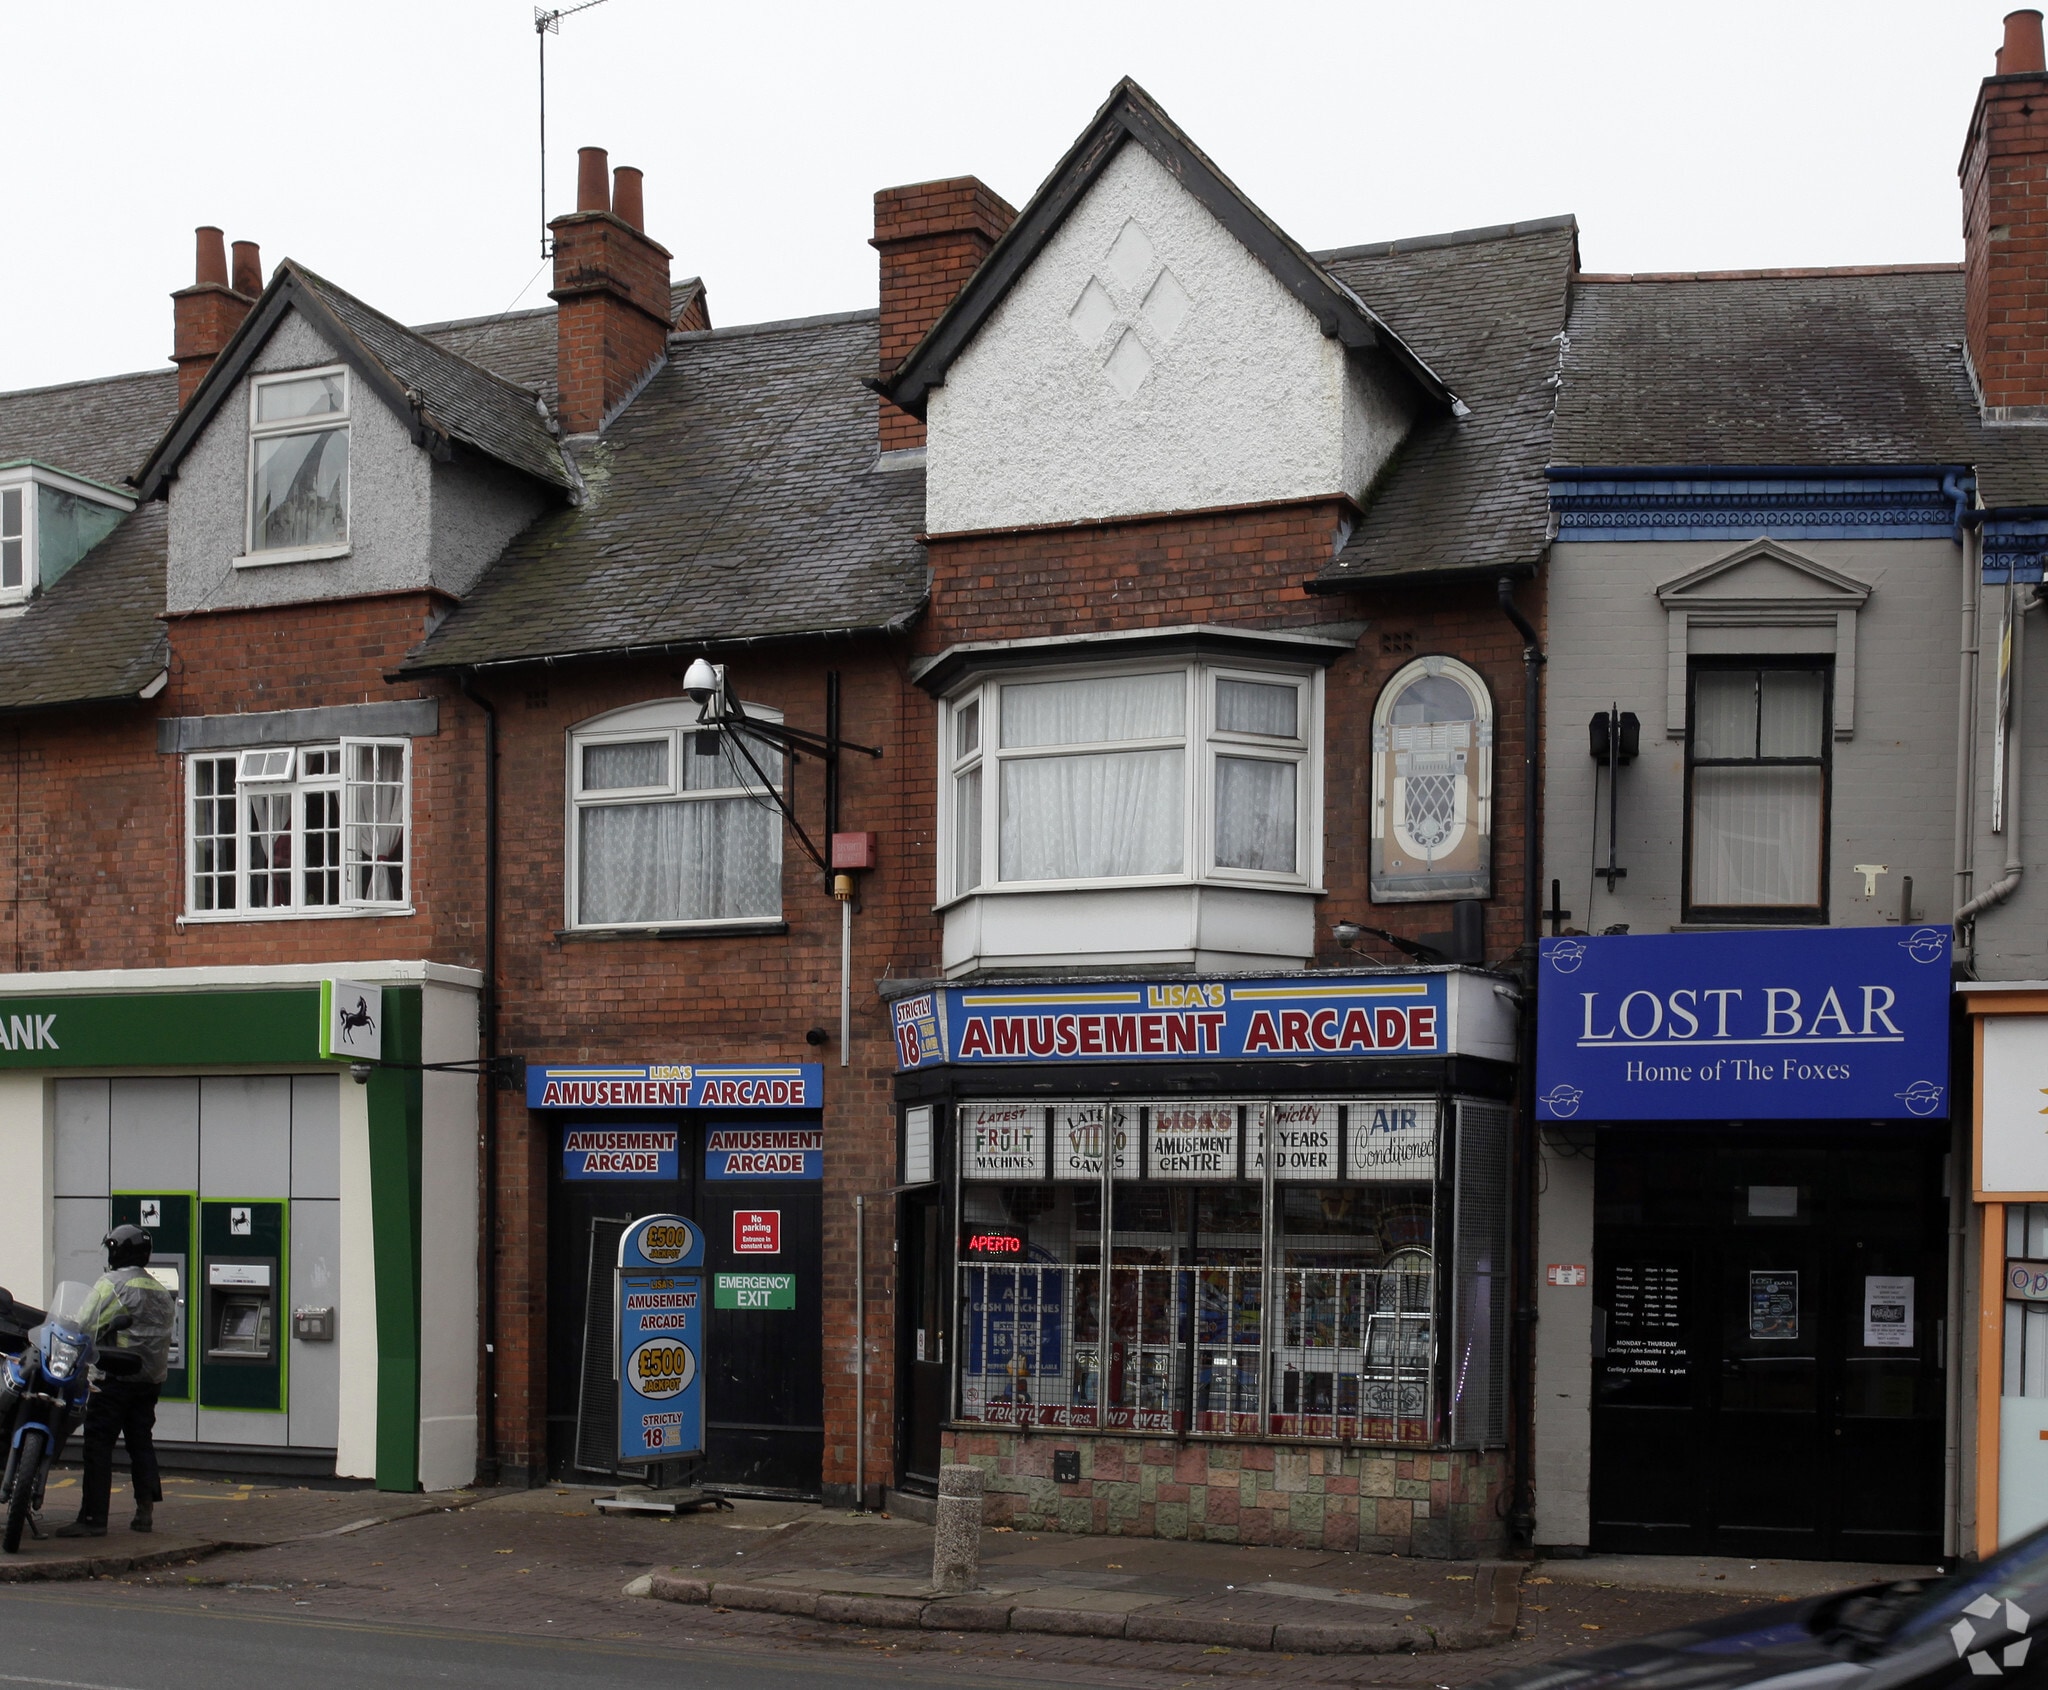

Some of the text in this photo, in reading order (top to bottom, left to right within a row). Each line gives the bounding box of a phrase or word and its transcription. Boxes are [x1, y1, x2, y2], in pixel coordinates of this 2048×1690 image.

[1147, 984, 1225, 1009] LISA'S
[896, 994, 931, 1023] STRICTLY
[1579, 985, 1904, 1040] LOST BAR
[958, 1005, 1437, 1058] AMUSEMENT ARCADE
[897, 1022, 921, 1067] 18
[649, 1065, 692, 1080] LISA'S
[1626, 1058, 1850, 1082] Home of The Foxes
[541, 1080, 805, 1106] AMUSEMENT ARCADE
[977, 1108, 1028, 1125] LATEST
[1155, 1109, 1232, 1134] LISA'S
[1369, 1108, 1417, 1135] AIR
[565, 1131, 677, 1151] AMUSEMENT
[707, 1130, 823, 1151] AMUSEMENT
[976, 1126, 1034, 1153] FRUIT
[1154, 1137, 1232, 1156] AMUSEMENT
[1280, 1132, 1328, 1148] YEARS
[1354, 1124, 1437, 1169] Conditioned
[582, 1152, 659, 1173] ARCADE
[724, 1152, 804, 1174] ARCADE
[977, 1155, 1034, 1170] MACHINES
[1159, 1154, 1221, 1171] CENTRE
[1255, 1152, 1328, 1168] AD OVER
[751, 1214, 762, 1223] No
[646, 1225, 686, 1247] £500
[742, 1223, 771, 1233] parking
[969, 1235, 1020, 1252] APERTO
[649, 1249, 680, 1259] JACKPOT
[650, 1279, 674, 1290] LISA'S
[718, 1276, 791, 1289] EMERGENCY
[626, 1293, 697, 1310] AMUSEMENT
[737, 1290, 772, 1307] EXIT
[1002, 1286, 1032, 1301] AL
[1005, 1303, 1059, 1313] MCHNES
[639, 1314, 686, 1331] ARCADE
[1010, 1333, 1037, 1347] RS
[638, 1347, 686, 1379] £500
[642, 1378, 681, 1393] JACKPOT
[1374, 1391, 1413, 1405] TRILE
[1382, 1401, 1407, 1411] BEL
[642, 1411, 683, 1427] STRICTLY
[1107, 1413, 1128, 1426] ND
[1212, 1416, 1261, 1432] LSA'
[642, 1427, 664, 1449] 18
